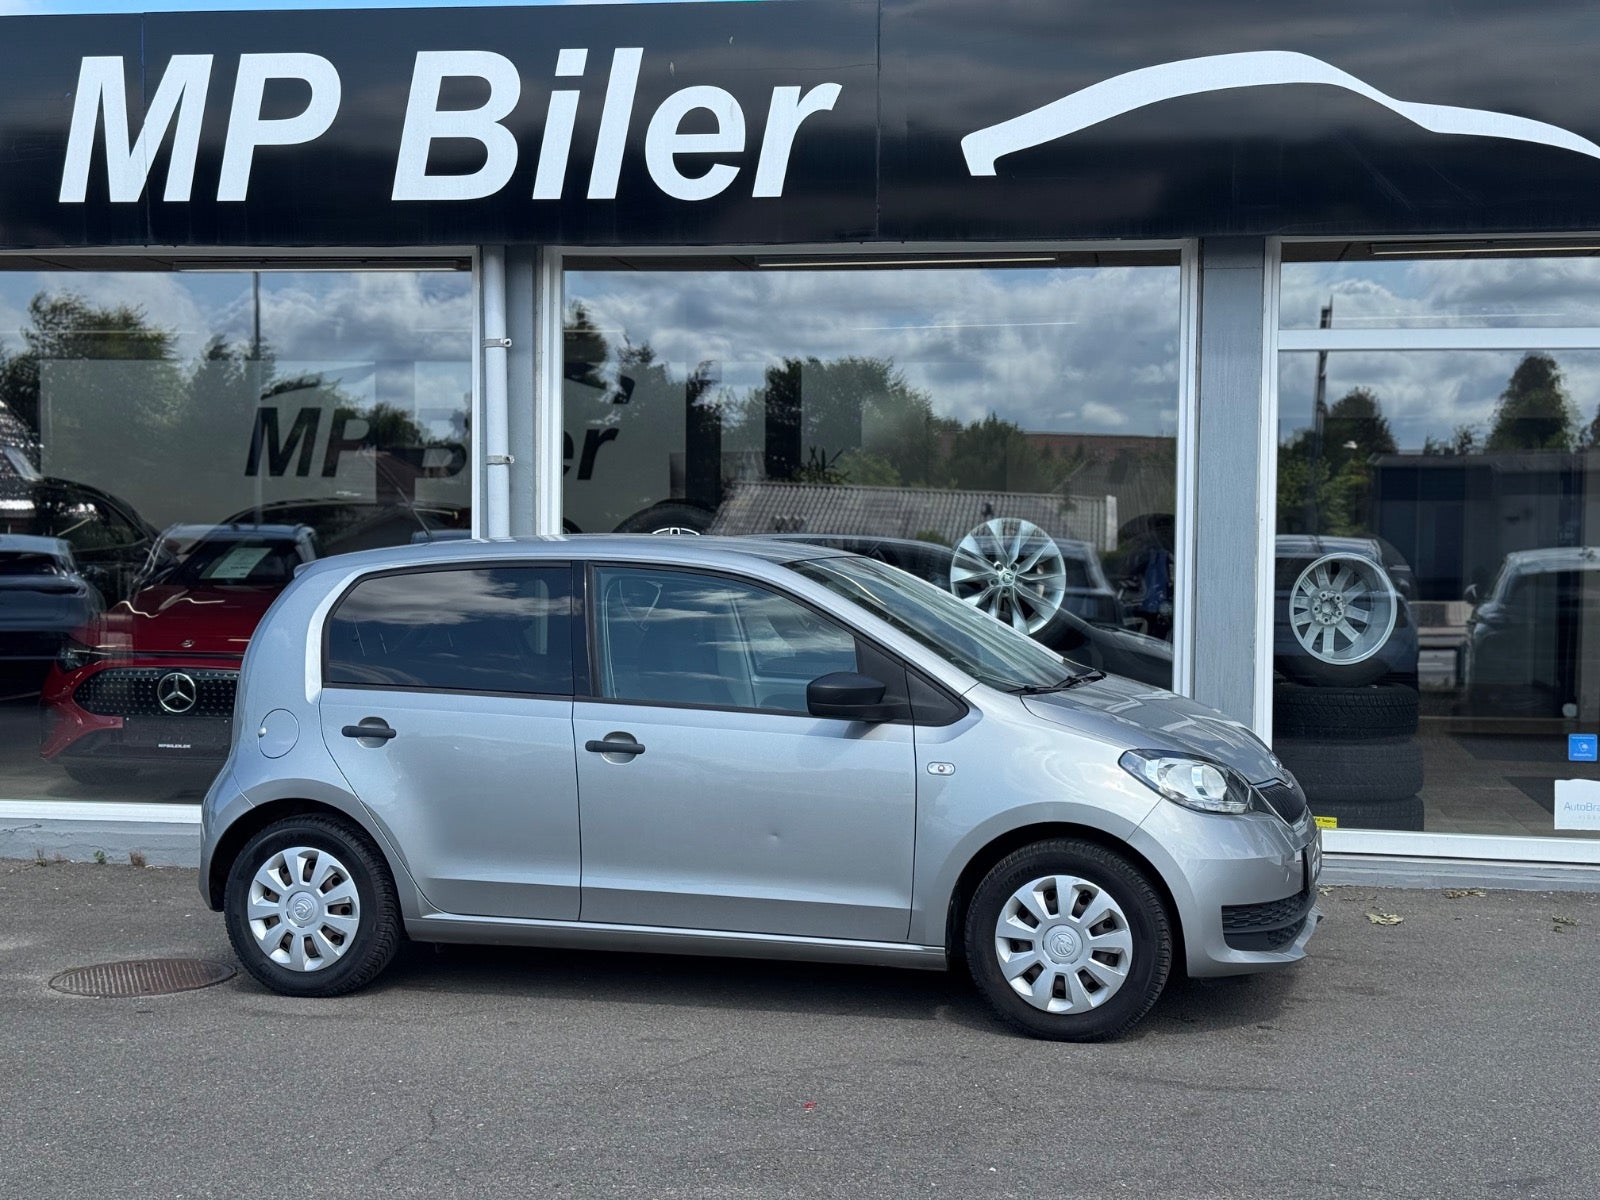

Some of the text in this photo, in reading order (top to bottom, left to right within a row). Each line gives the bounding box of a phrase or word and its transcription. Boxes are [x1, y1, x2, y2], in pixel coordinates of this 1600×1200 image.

[59, 48, 842, 202] MP Biler
[245, 407, 373, 478] MP
